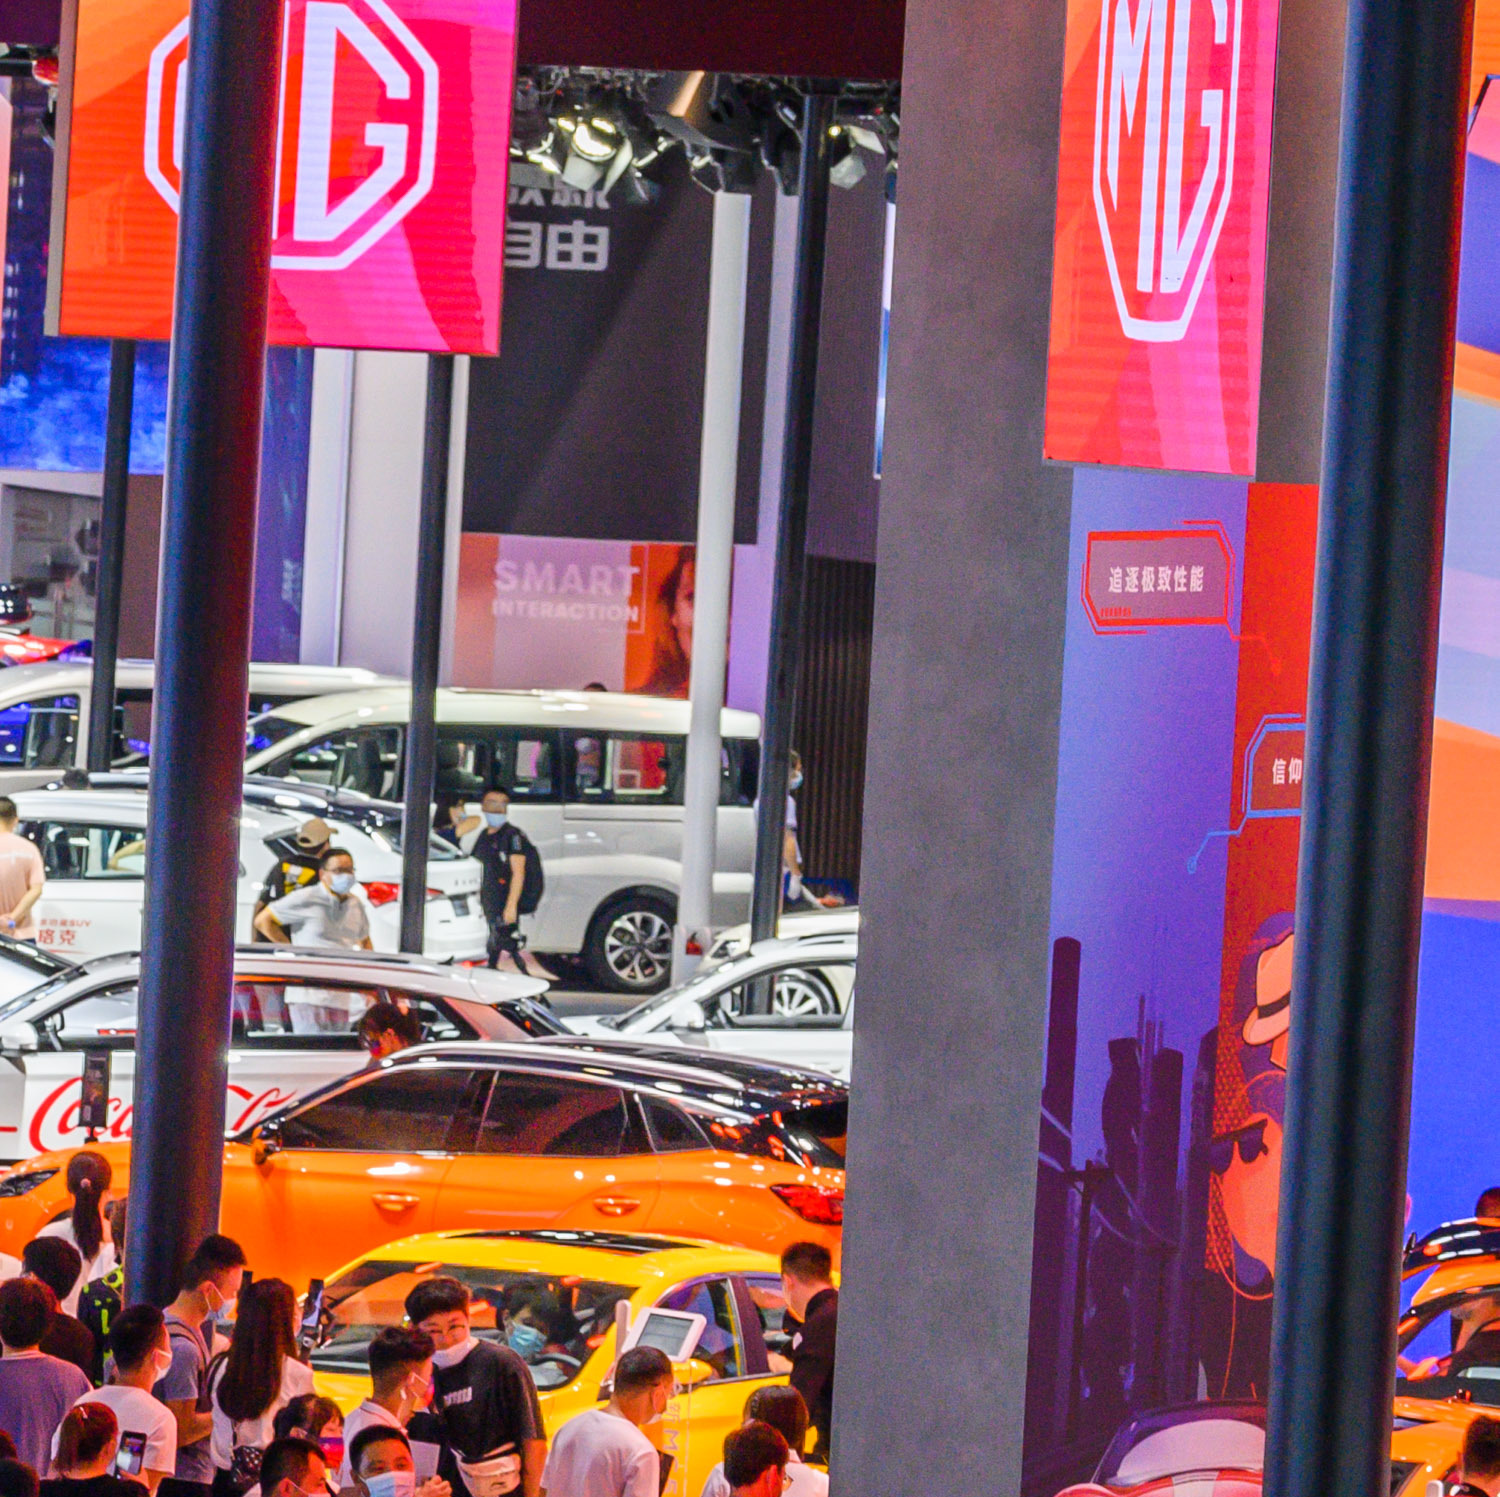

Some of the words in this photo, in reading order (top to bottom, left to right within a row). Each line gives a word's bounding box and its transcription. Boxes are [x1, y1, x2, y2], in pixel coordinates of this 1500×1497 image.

[1107, 0, 1226, 293] MG
[503, 220, 610, 271] 自由
[494, 559, 640, 596] SMART
[1108, 565, 1204, 593] 追逐极致性能
[492, 600, 639, 623] INTERACTION
[1271, 757, 1303, 785] 信仰
